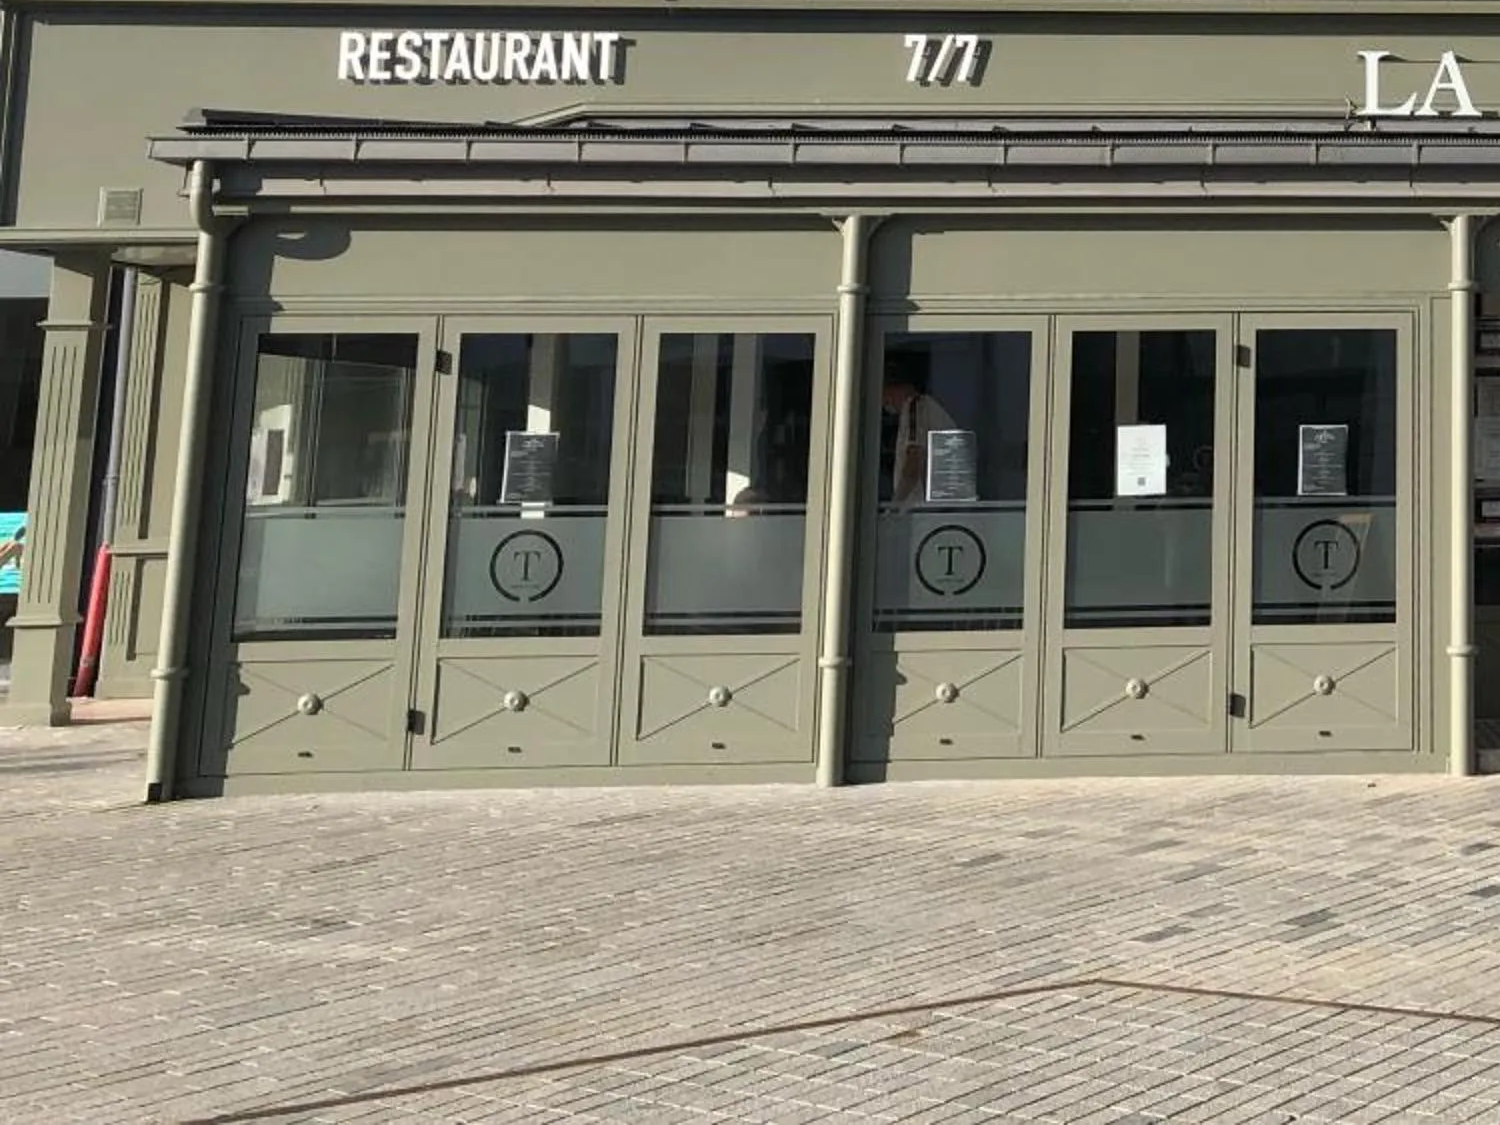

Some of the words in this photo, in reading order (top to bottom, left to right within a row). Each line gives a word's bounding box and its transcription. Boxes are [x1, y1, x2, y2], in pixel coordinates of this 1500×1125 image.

[337, 29, 621, 82] RESTAURANT
[903, 33, 979, 83] 7/7
[1357, 49, 1484, 118] LA
[513, 551, 541, 582] T
[938, 546, 963, 576] T
[1314, 540, 1339, 570] T
